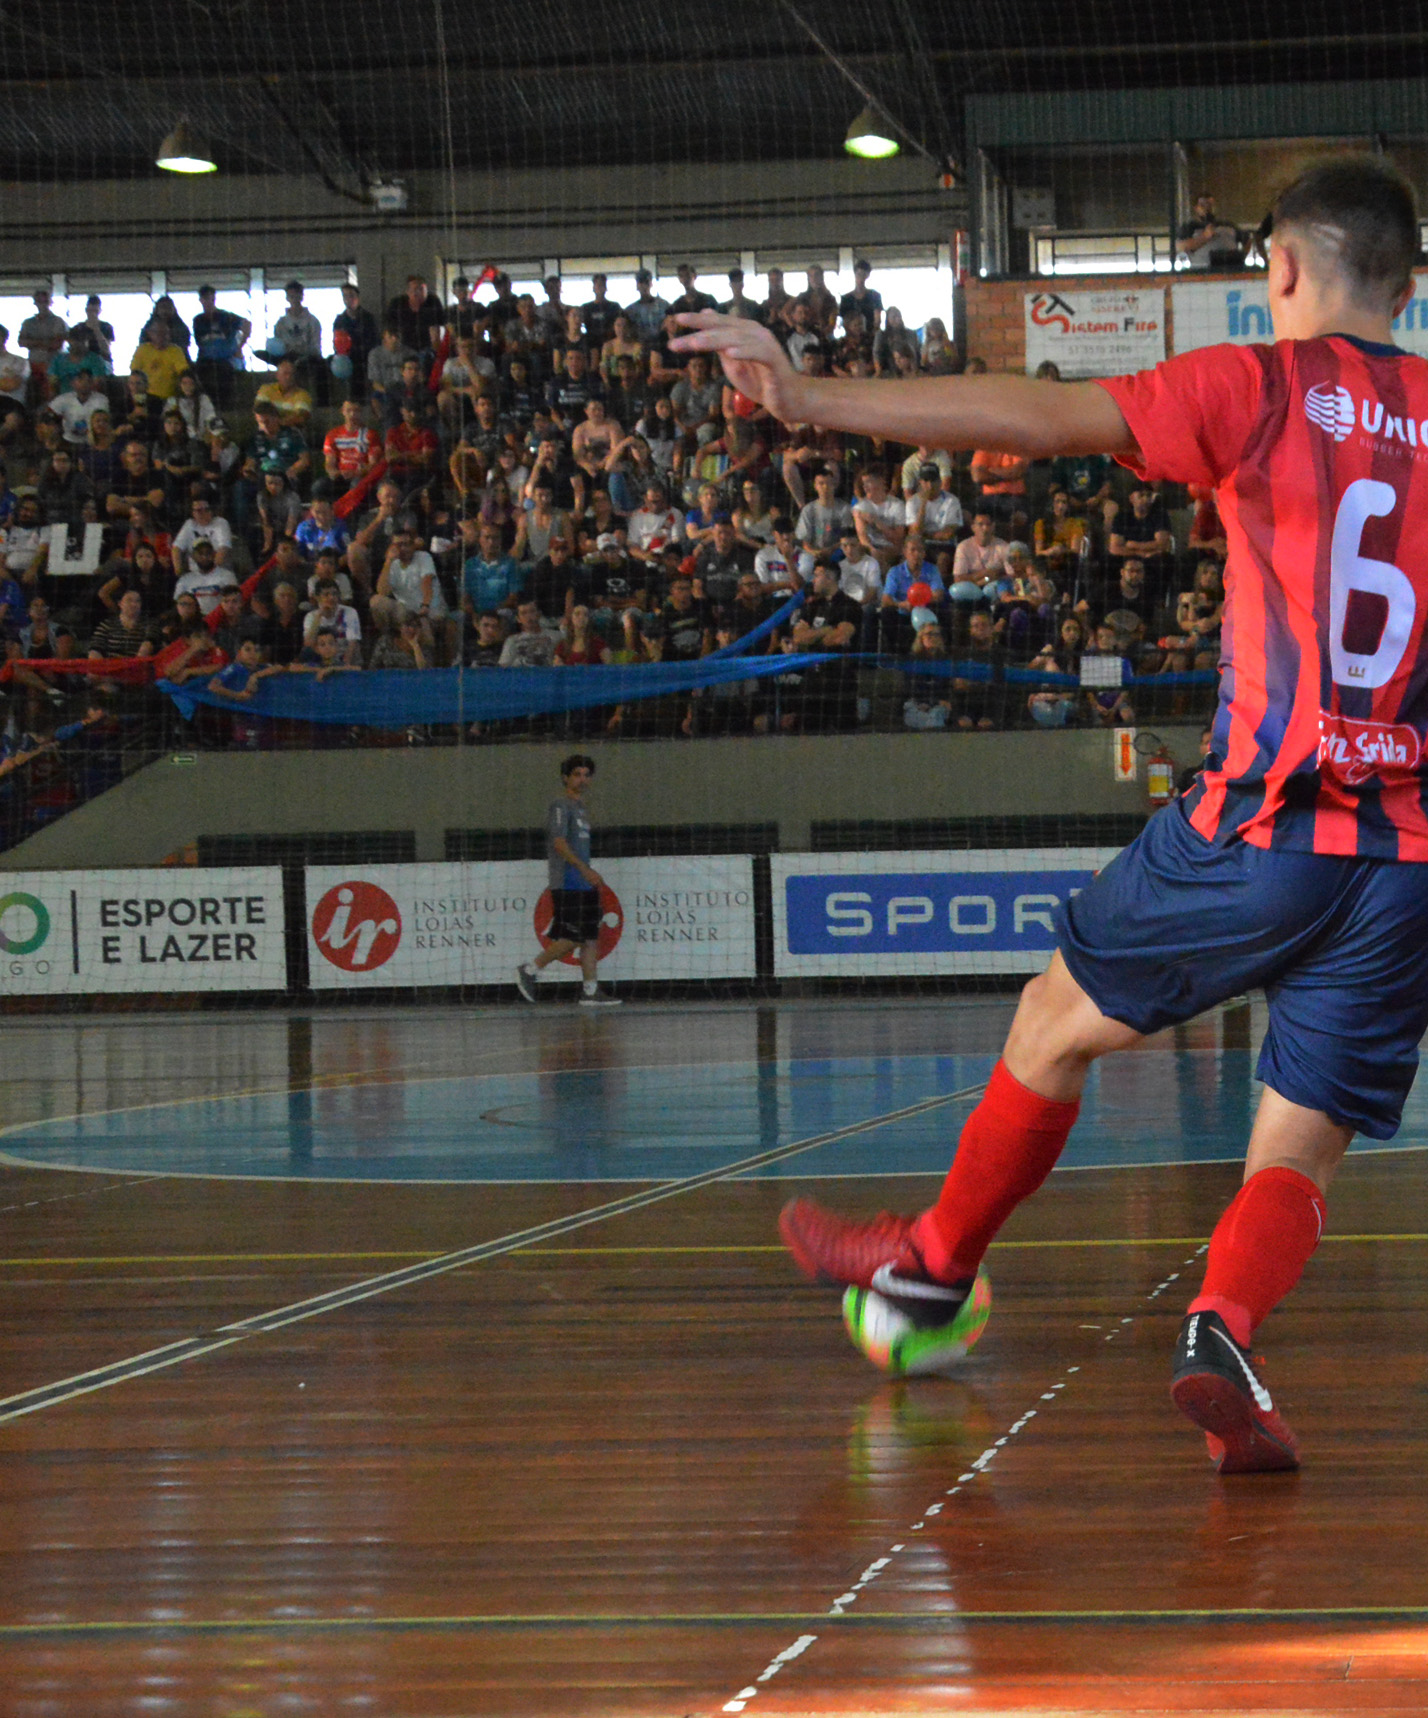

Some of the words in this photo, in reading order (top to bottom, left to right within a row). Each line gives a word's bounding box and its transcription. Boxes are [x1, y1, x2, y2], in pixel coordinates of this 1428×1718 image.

[1330, 478, 1416, 688] 6
[414, 896, 527, 914] INSTITUTO
[636, 890, 750, 908] INSTITUTO
[101, 896, 266, 927] ESPORTE
[636, 909, 697, 925] LOJAS
[825, 888, 1080, 937] SPOR
[415, 915, 475, 932] LOJAS
[416, 933, 496, 948] RENNER
[637, 926, 719, 943] RENNER
[102, 935, 122, 964] E
[140, 932, 257, 963] LAZER
